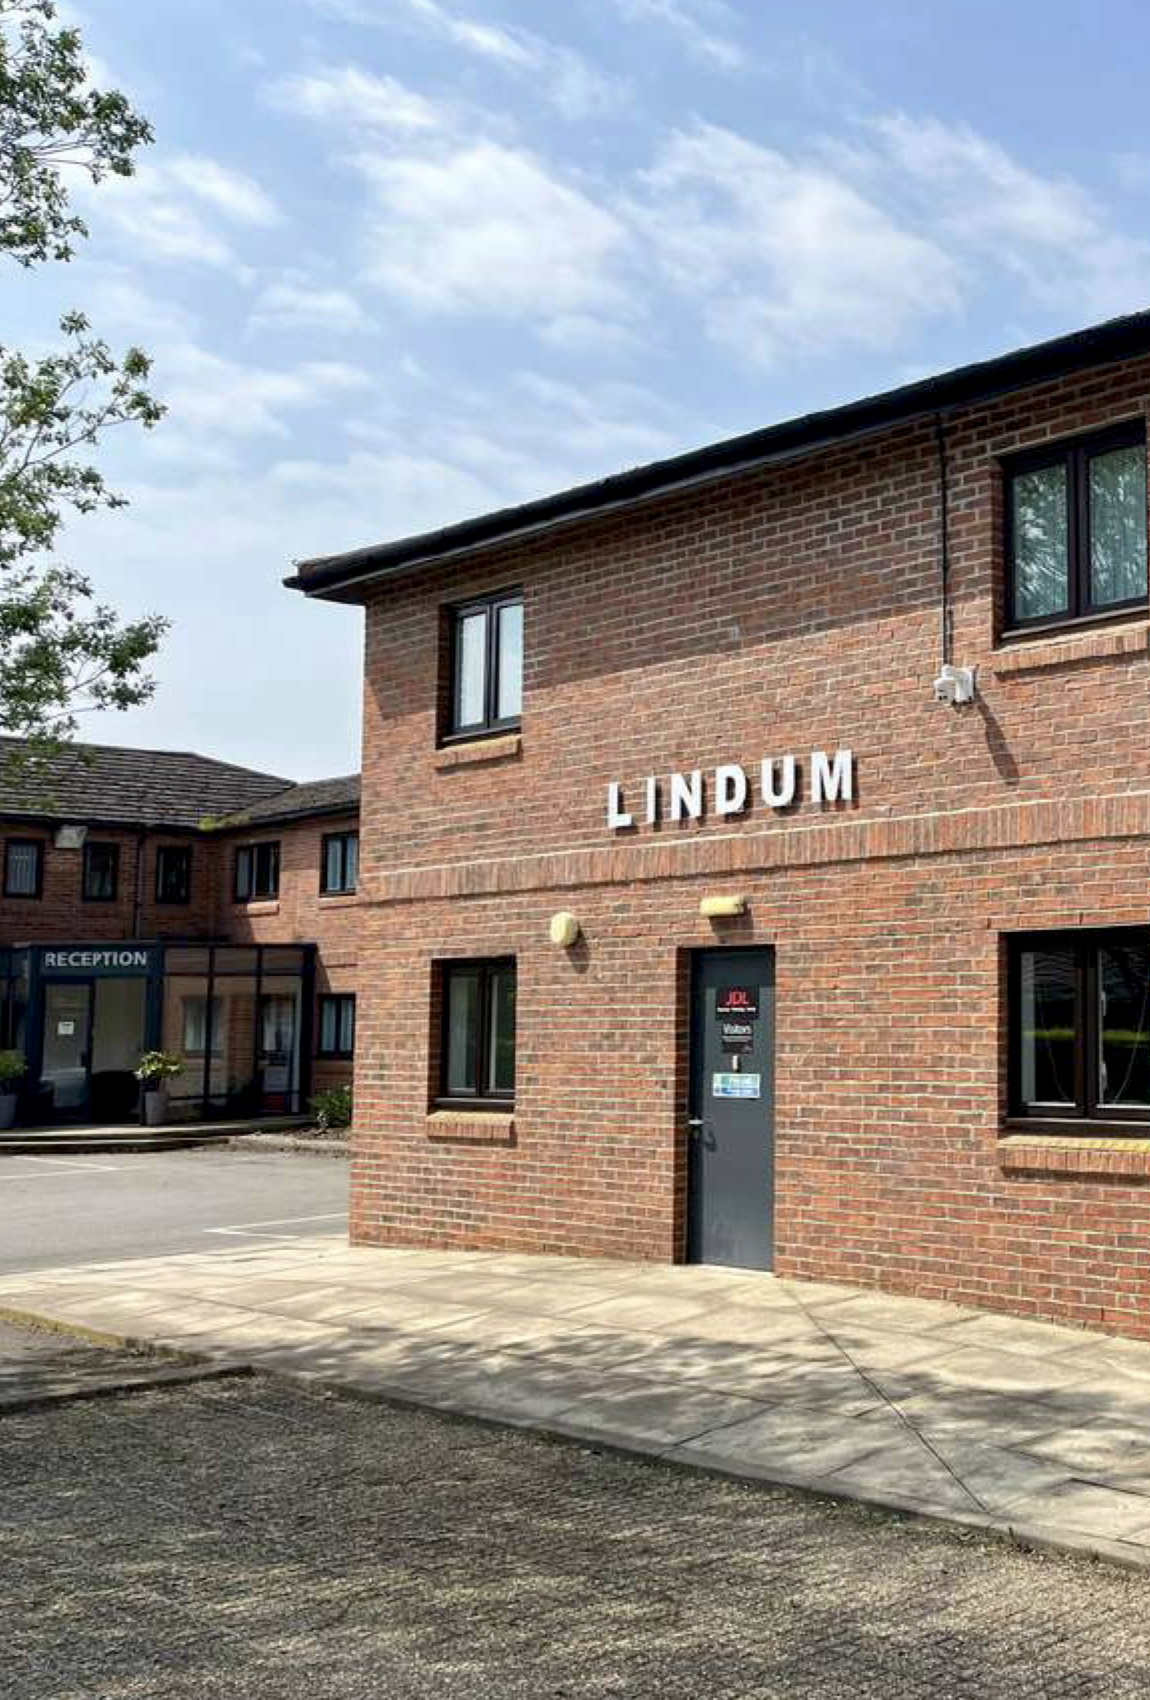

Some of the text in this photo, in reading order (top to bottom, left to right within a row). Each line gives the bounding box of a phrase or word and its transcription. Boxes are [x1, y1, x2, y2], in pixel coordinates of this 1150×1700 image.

[608, 749, 852, 828] LINDUM
[45, 951, 147, 967] RECEPTION
[726, 991, 749, 1005] JDL
